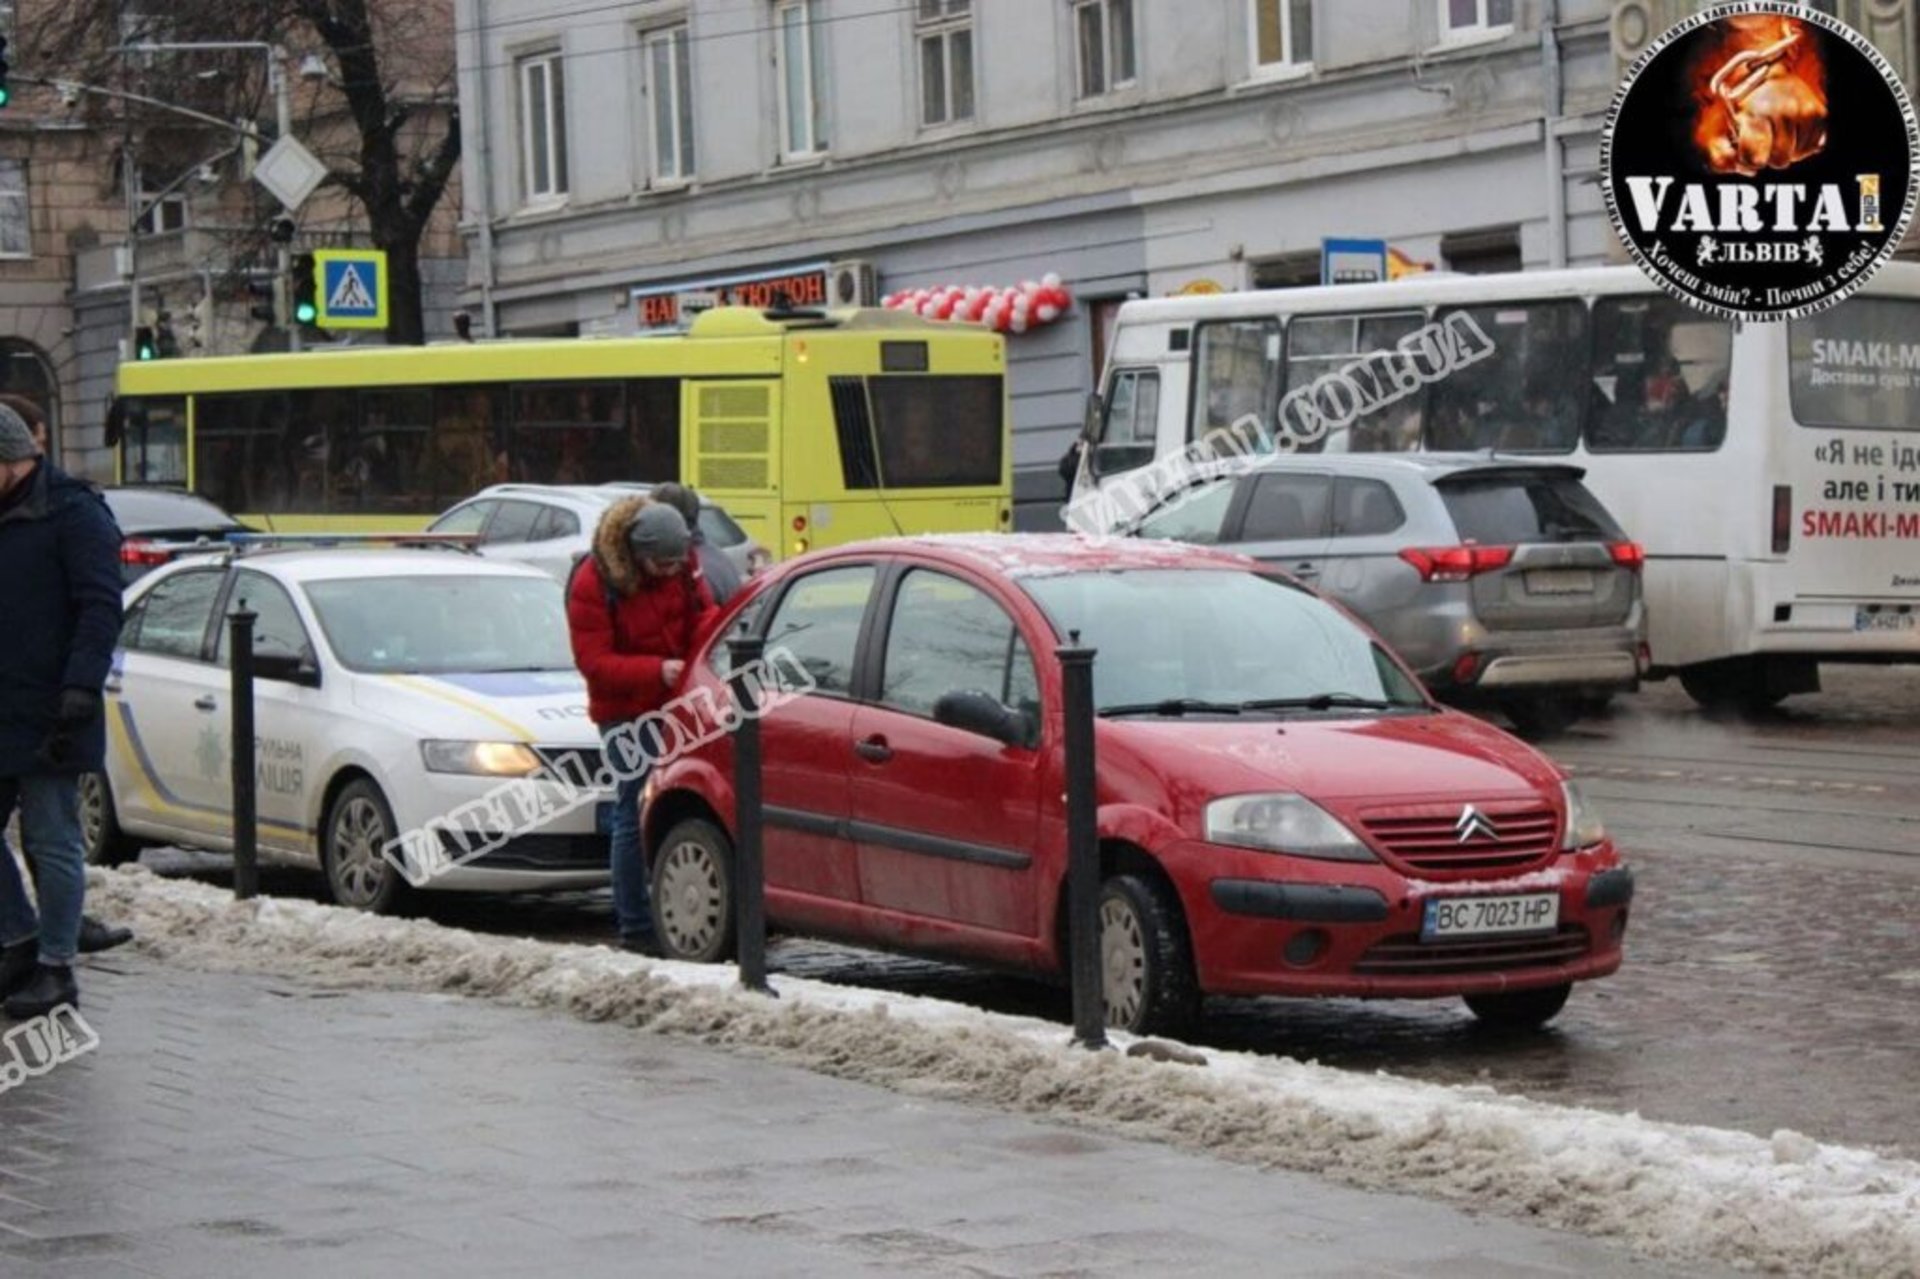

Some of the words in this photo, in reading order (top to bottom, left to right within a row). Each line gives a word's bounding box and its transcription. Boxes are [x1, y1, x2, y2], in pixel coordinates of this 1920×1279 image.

[1853, 445, 1883, 467] не
[1823, 480, 1868, 501] але
[1438, 904, 1469, 930] BC
[1474, 901, 1520, 928] 7023
[1523, 898, 1551, 925] HP
